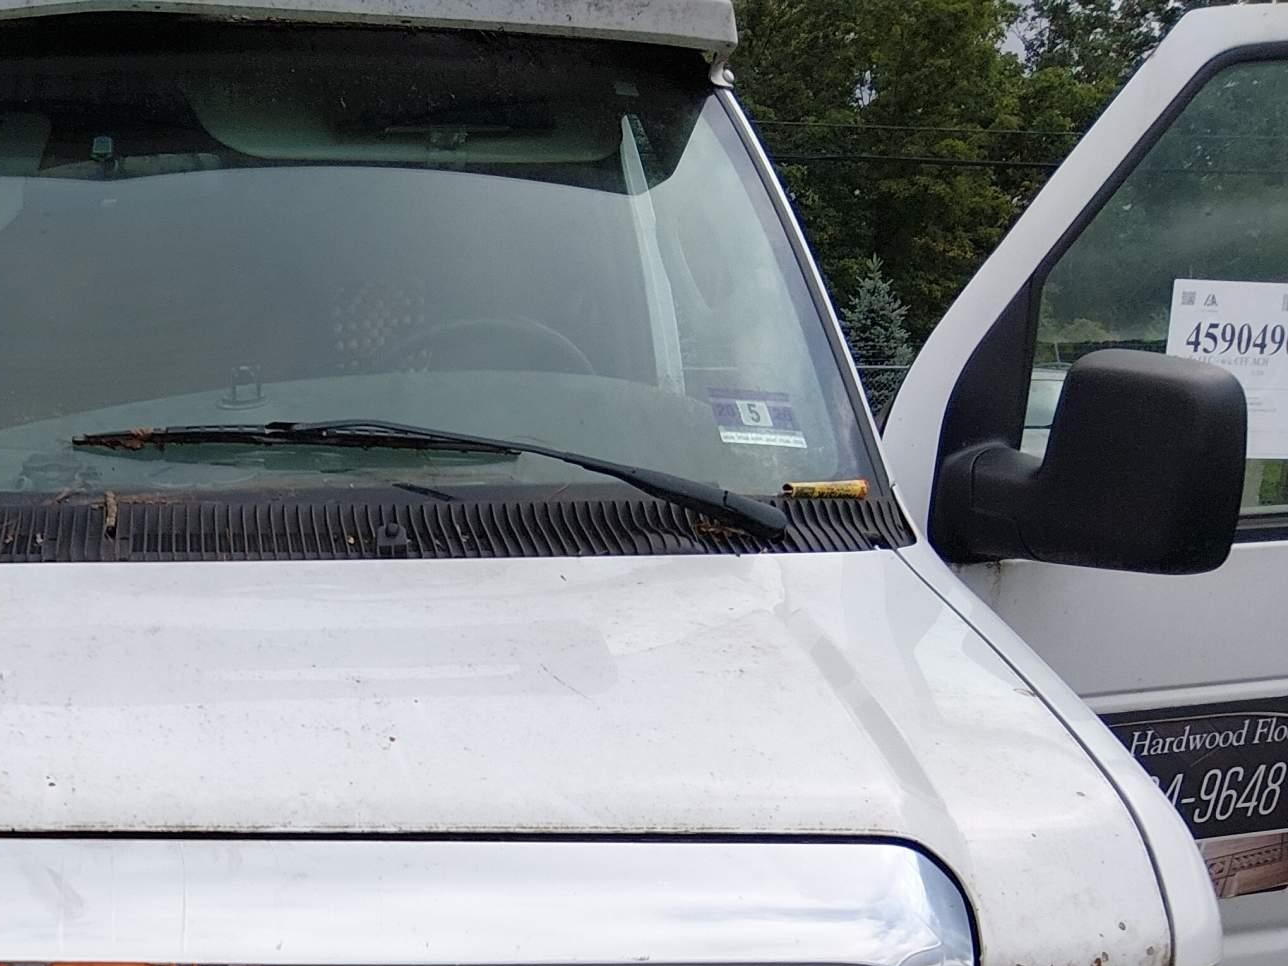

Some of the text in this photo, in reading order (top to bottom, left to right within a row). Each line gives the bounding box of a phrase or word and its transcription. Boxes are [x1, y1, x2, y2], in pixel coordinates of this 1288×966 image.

[1185, 321, 1288, 356] 459049
[746, 402, 761, 423] 5
[1130, 717, 1288, 757] Hardwood Flo
